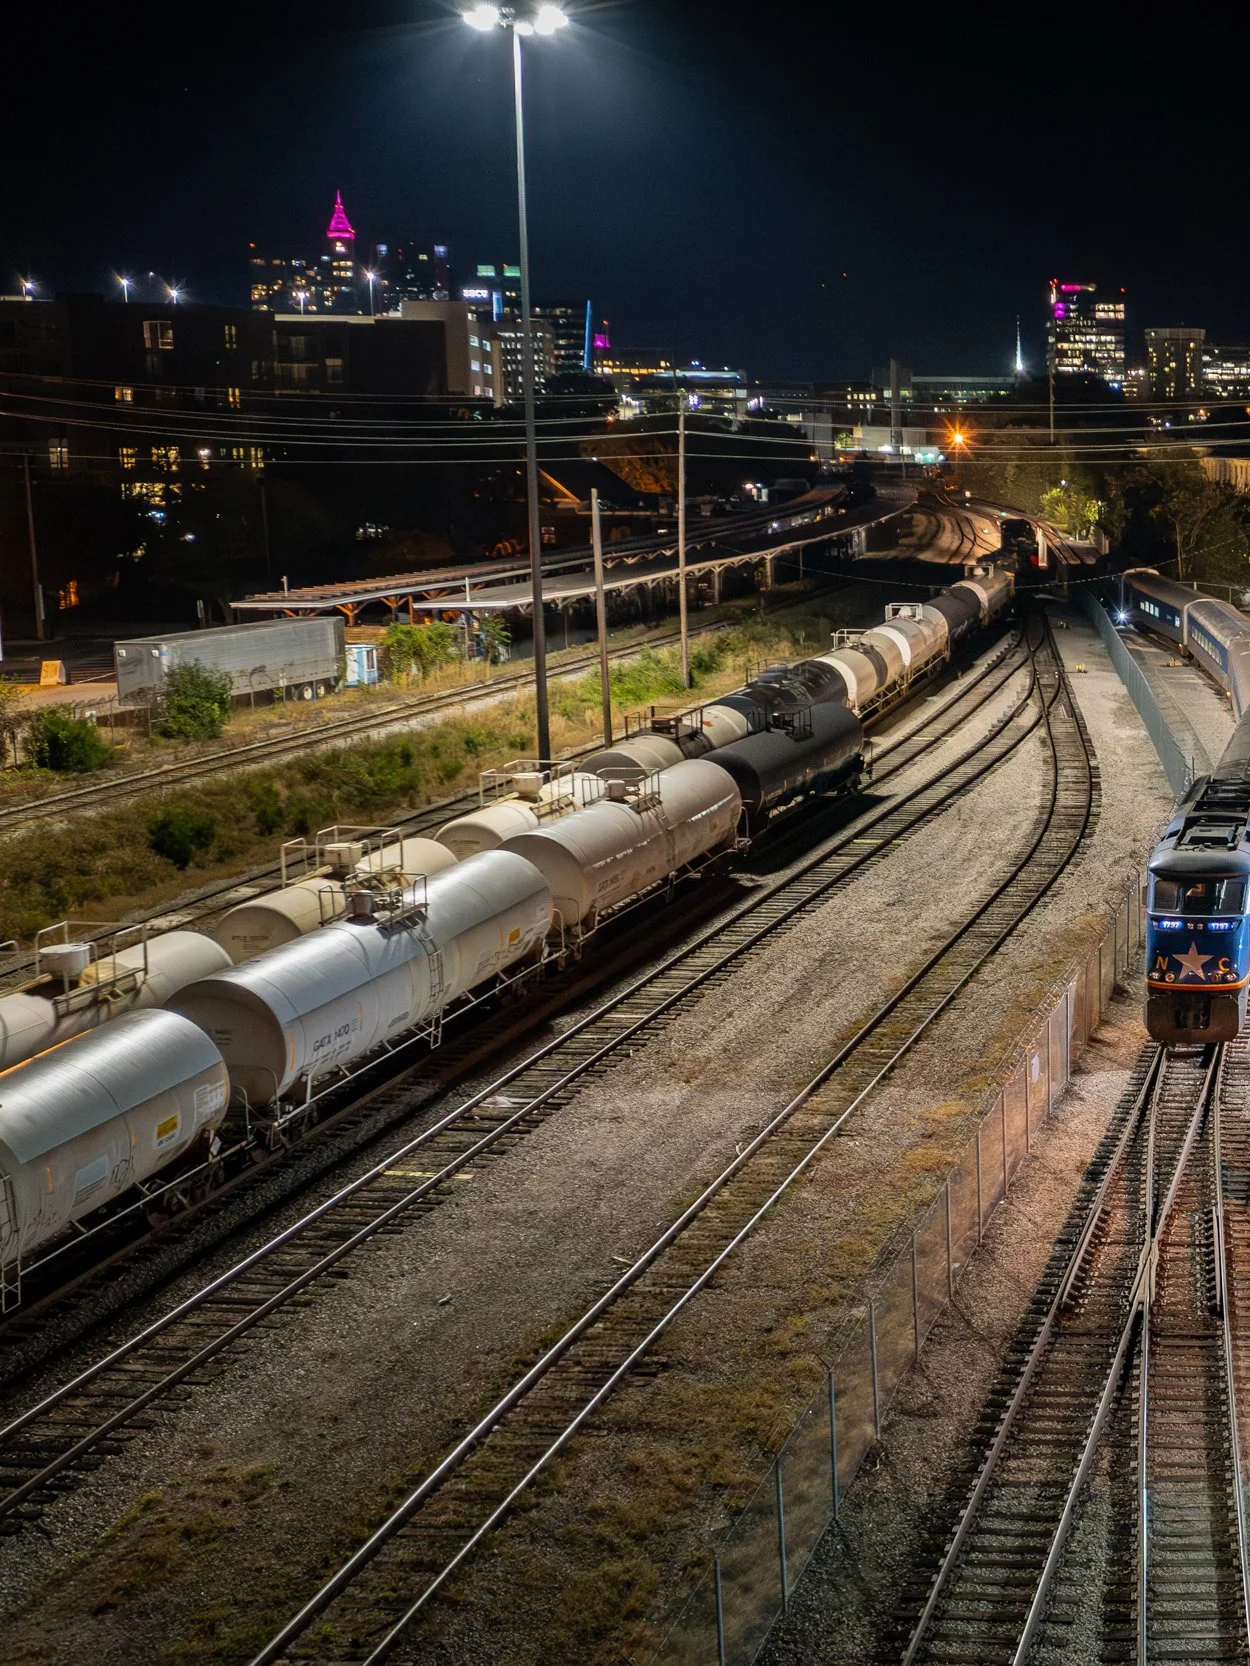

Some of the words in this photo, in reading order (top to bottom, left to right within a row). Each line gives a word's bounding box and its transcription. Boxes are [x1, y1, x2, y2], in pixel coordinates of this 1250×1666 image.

[1162, 921, 1180, 929] 1797
[1211, 922, 1229, 930] 1797
[1156, 956, 1169, 970] N
[1217, 957, 1230, 972] C
[313, 1034, 331, 1052] GATX
